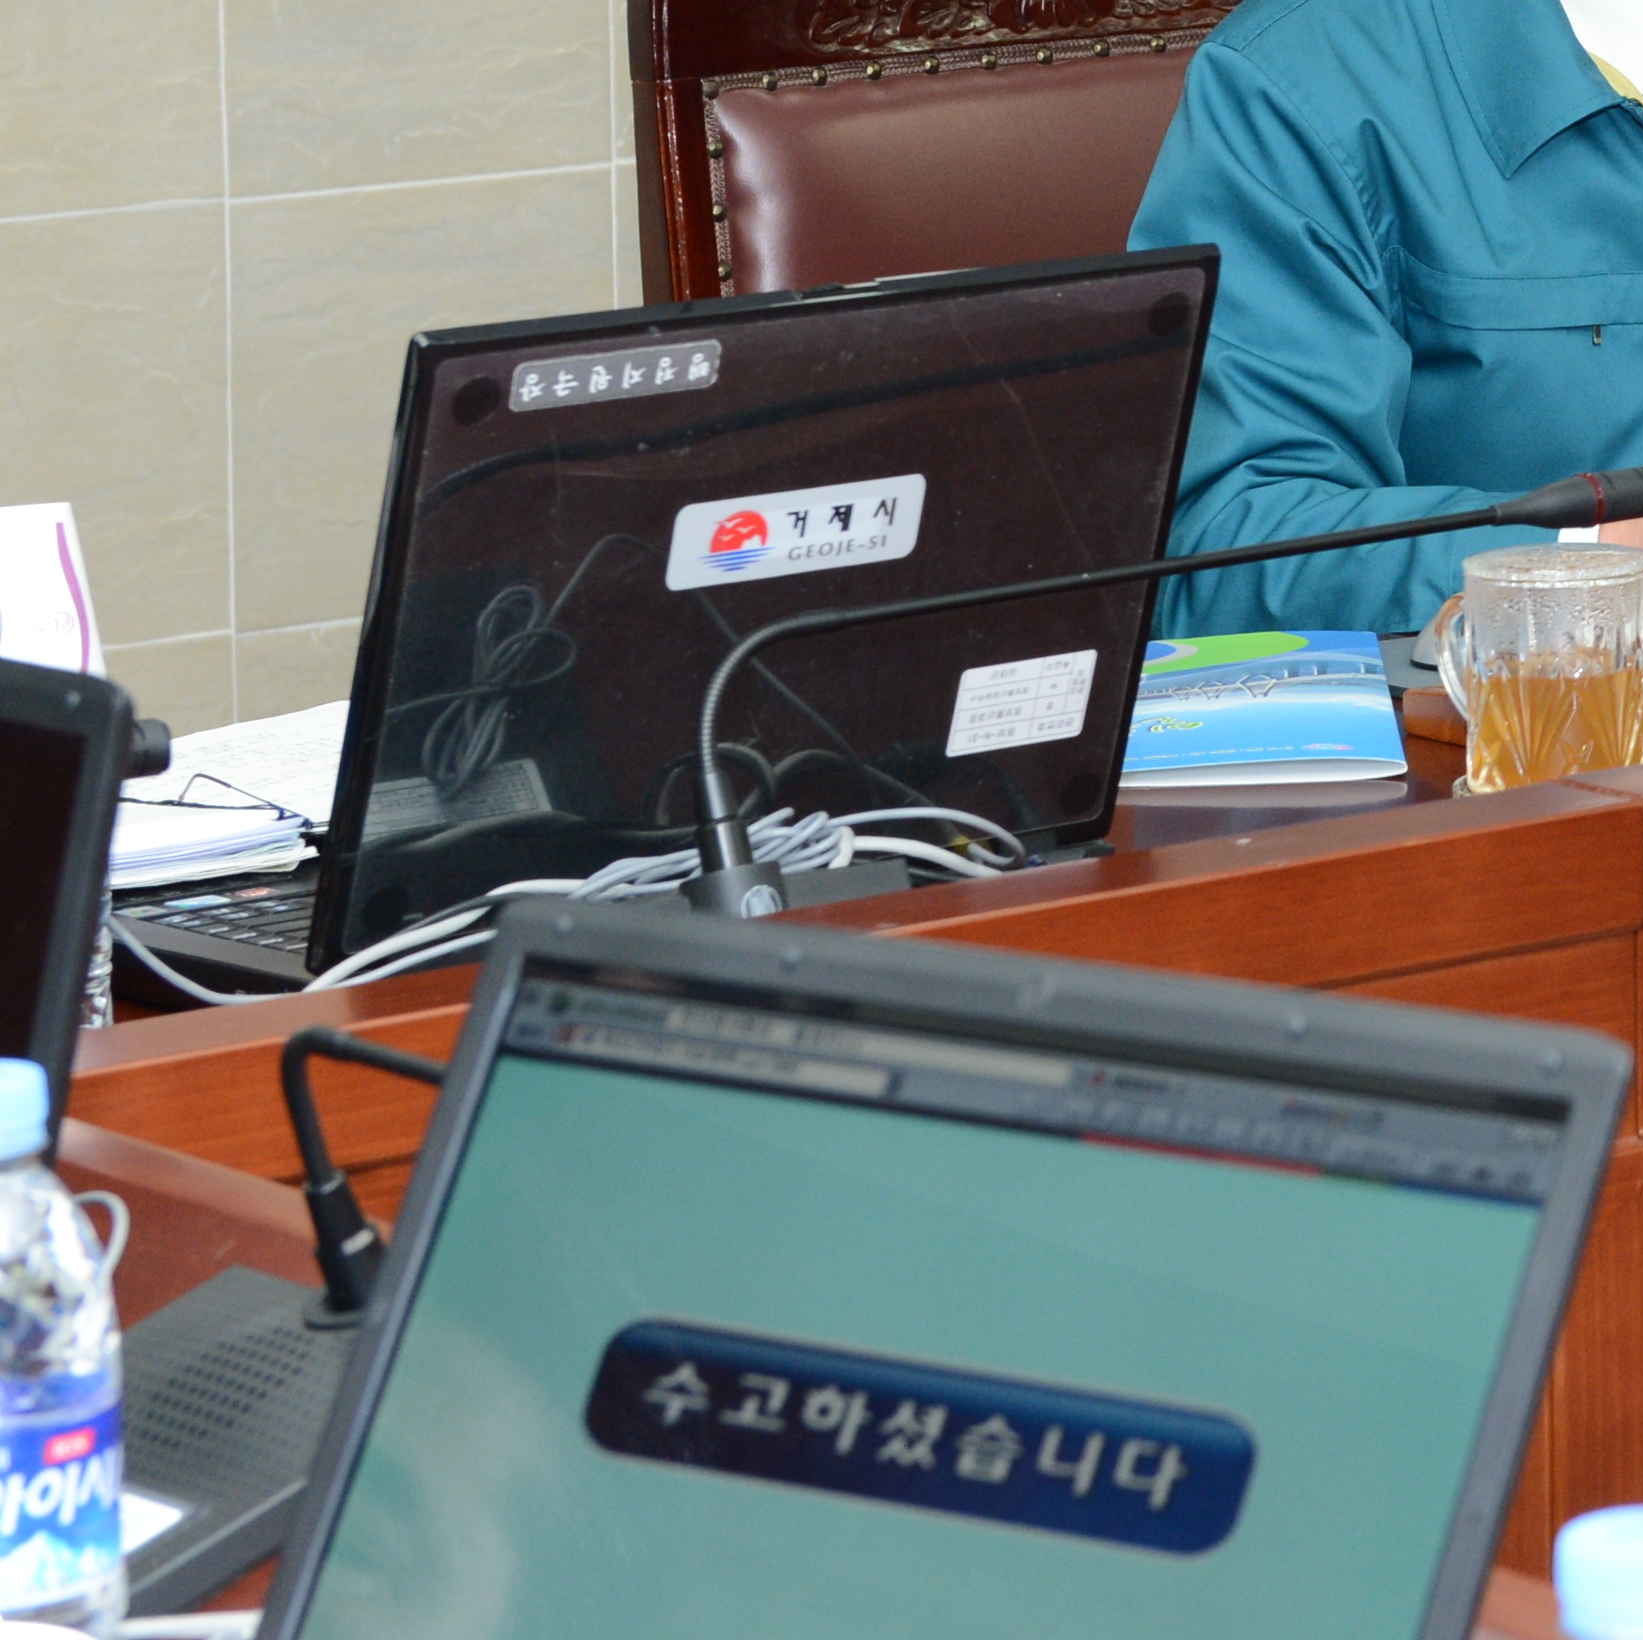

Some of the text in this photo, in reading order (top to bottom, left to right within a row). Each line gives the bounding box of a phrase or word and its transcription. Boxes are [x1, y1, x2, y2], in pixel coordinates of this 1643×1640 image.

[787, 497, 898, 538] 거제시
[788, 535, 887, 561] GEOJE-SI
[640, 1358, 1188, 1512] 수고하셨습니다
